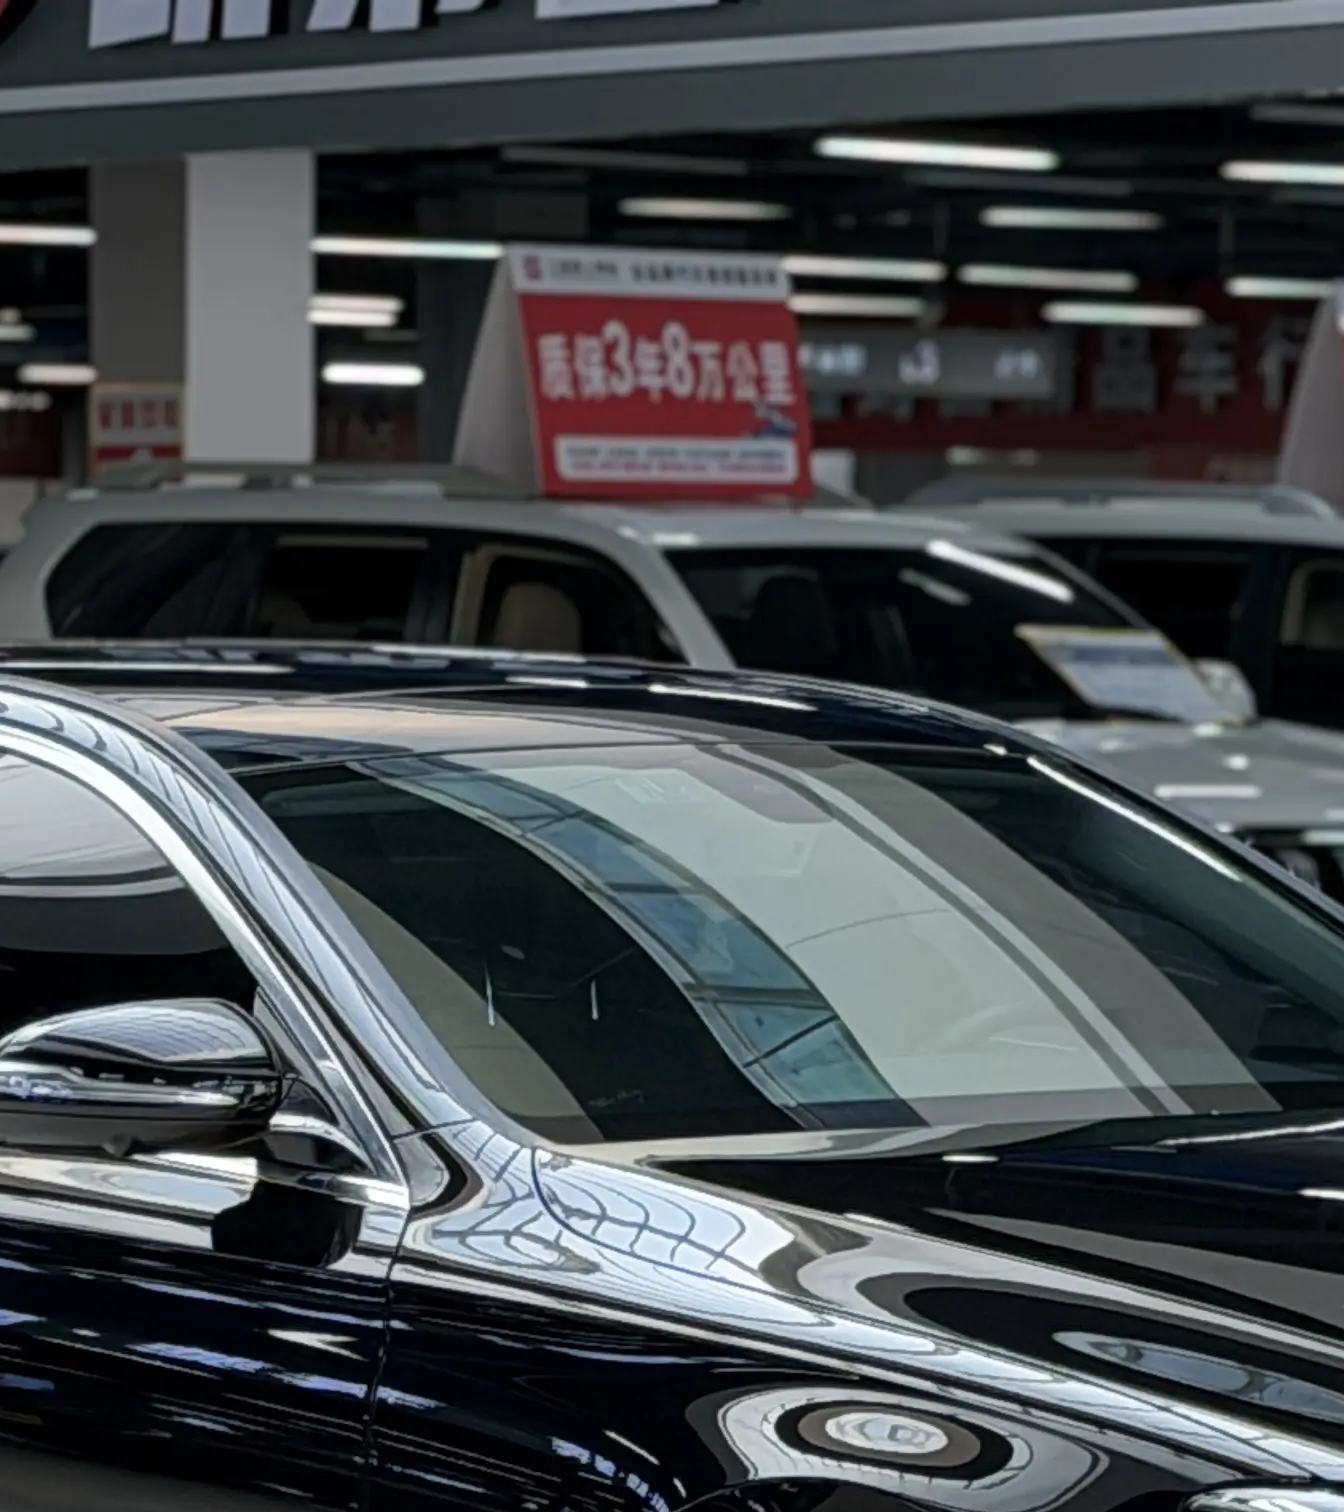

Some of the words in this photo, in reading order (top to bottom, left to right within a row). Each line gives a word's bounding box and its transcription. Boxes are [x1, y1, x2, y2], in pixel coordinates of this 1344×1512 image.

[537, 318, 798, 405] 质保3年8万公里
